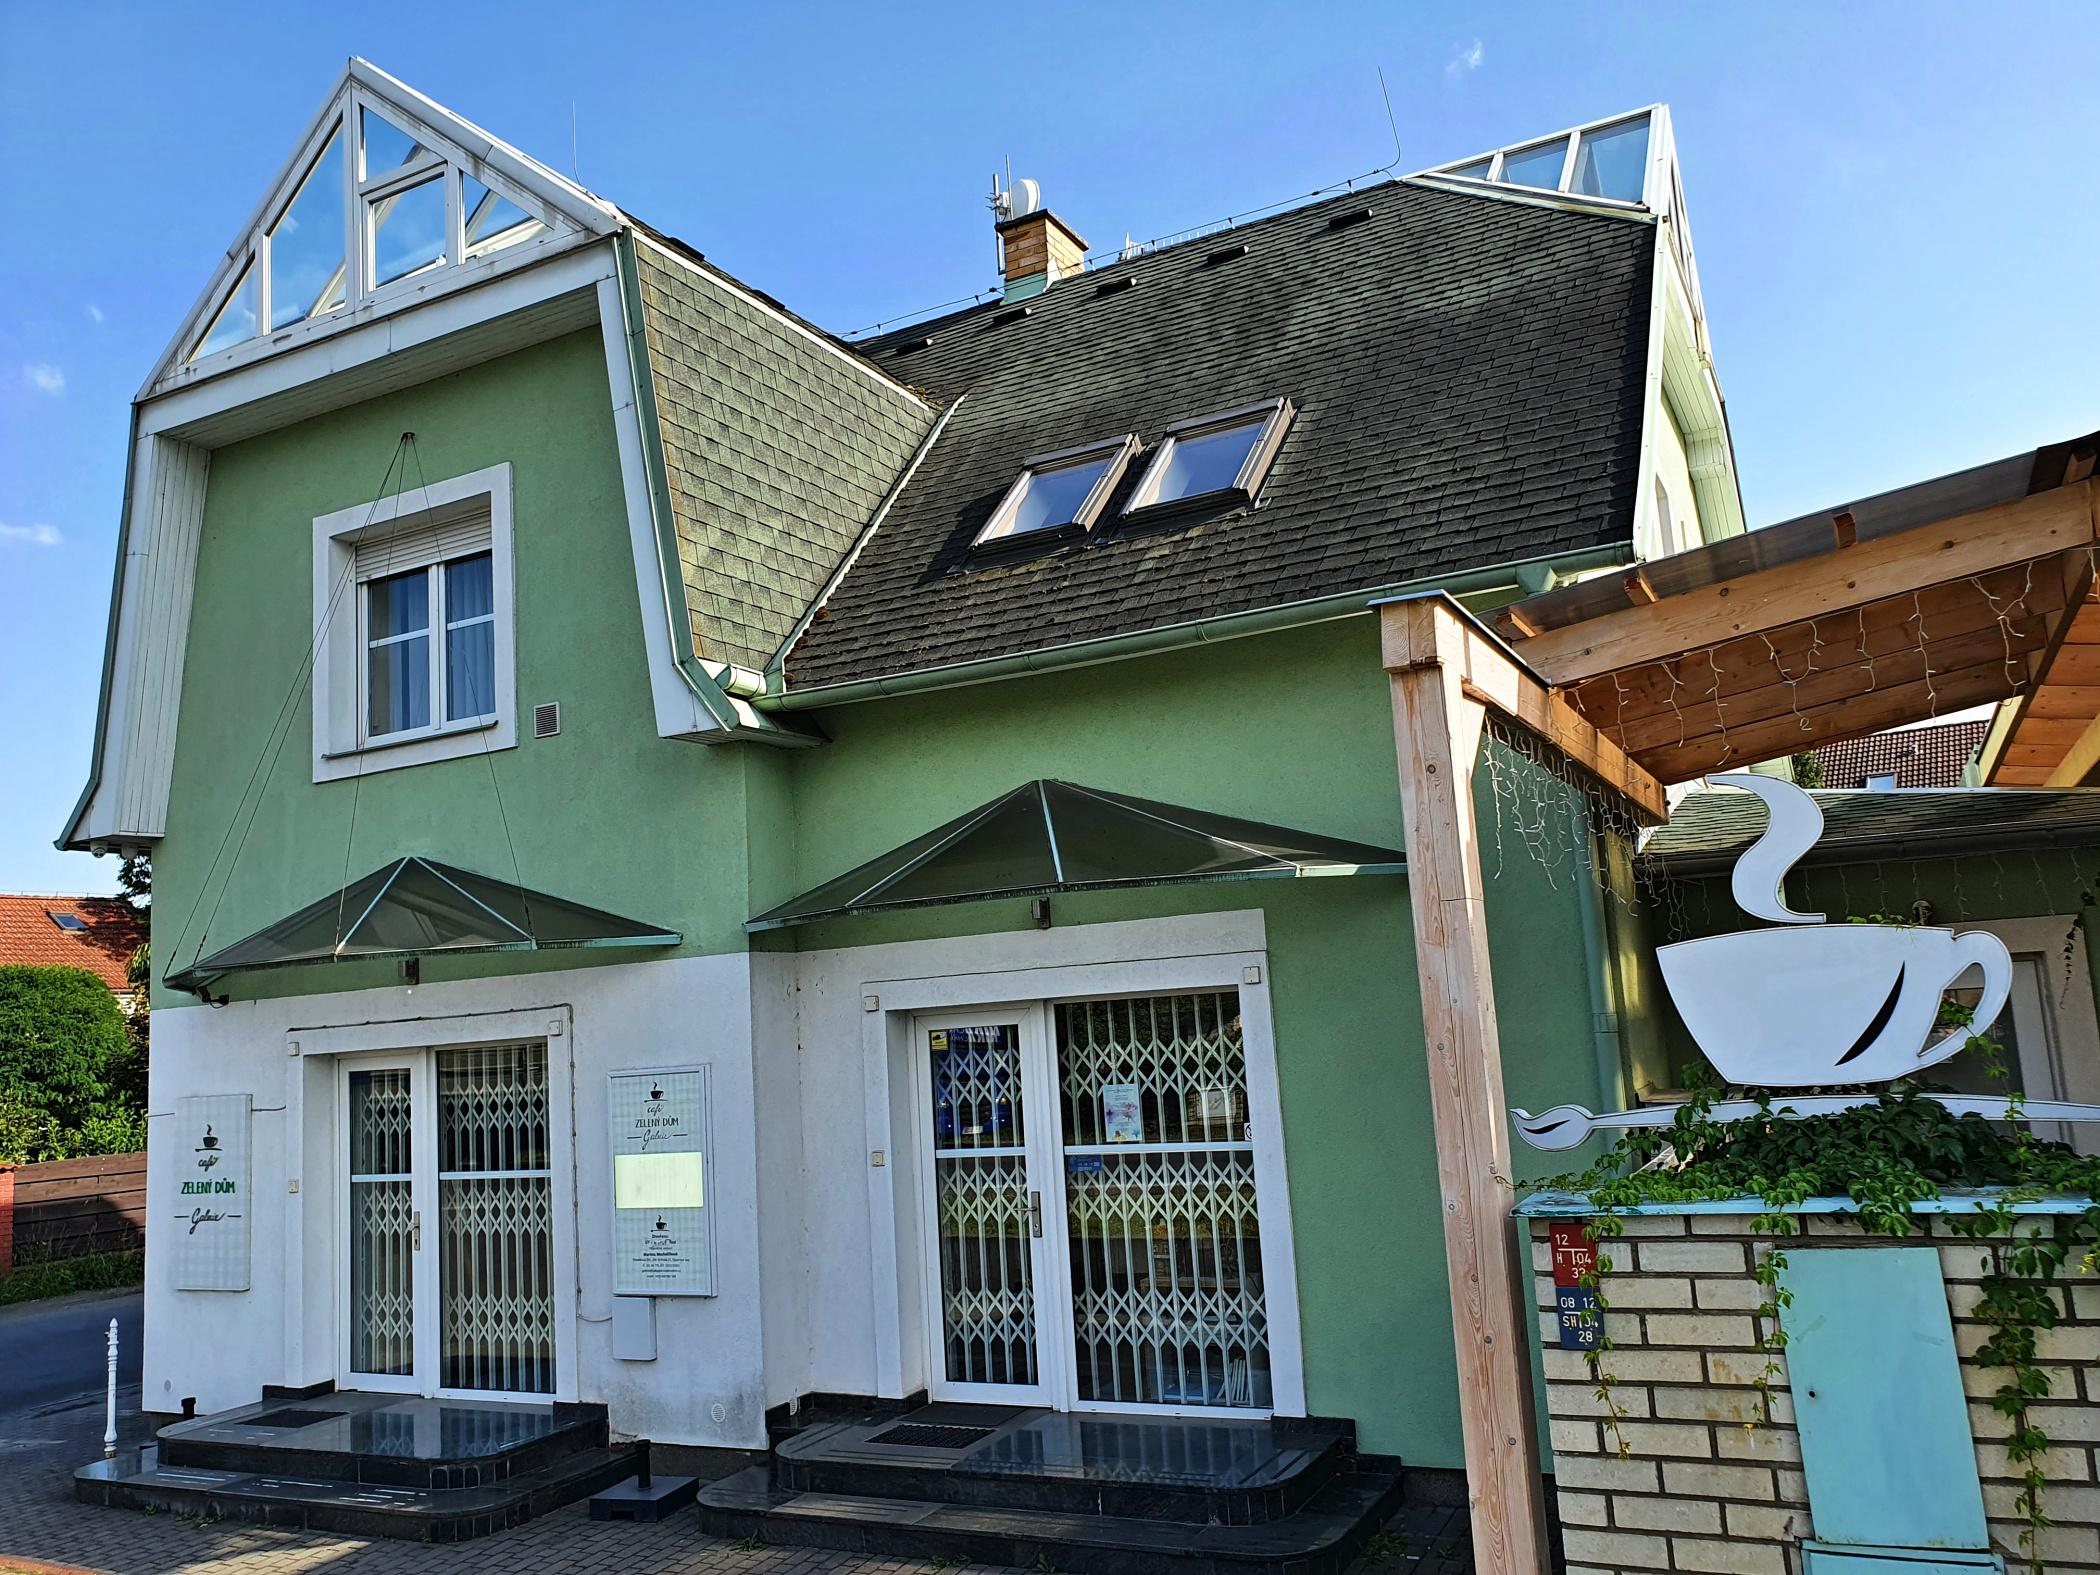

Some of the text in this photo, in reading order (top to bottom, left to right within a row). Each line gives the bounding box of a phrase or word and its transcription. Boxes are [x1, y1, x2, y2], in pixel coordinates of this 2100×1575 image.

[635, 1115, 679, 1128] ZELENÝ DŮM
[181, 1177, 236, 1194] ZELENÝ DŮM
[1555, 1234, 1569, 1246] 12
[1556, 1252, 1592, 1265] H 04
[1560, 1297, 1597, 1309] 08 12
[1562, 1315, 1577, 1328] SH
[1578, 1330, 1593, 1343] 28
